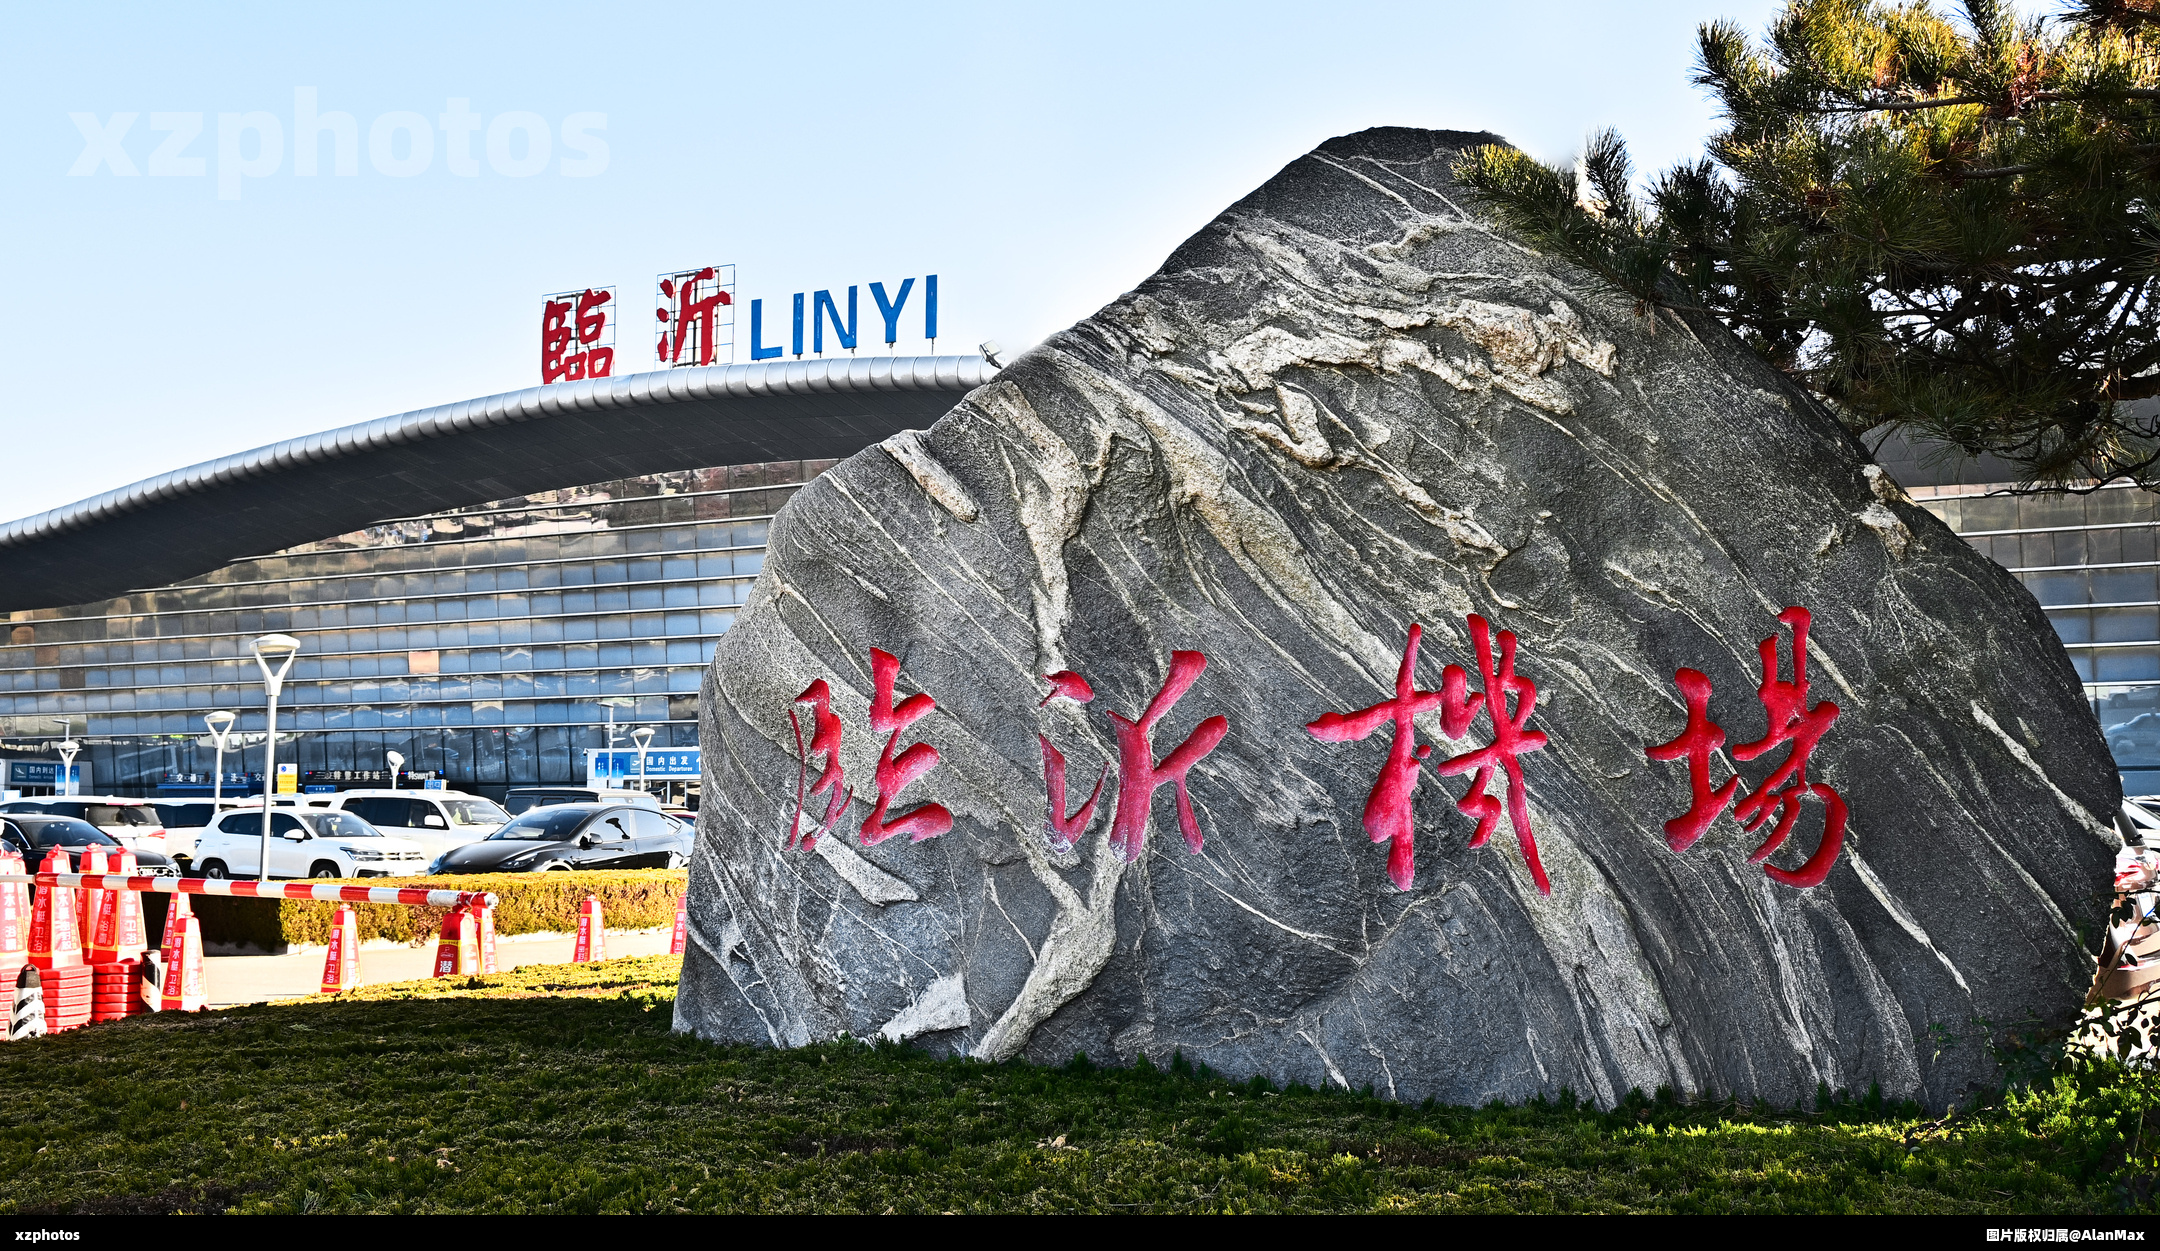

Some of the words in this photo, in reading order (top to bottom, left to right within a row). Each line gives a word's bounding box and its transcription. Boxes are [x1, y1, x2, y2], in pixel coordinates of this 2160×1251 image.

[751, 274, 938, 361] LINYI
[646, 756, 689, 766] 国内出发
[29, 766, 54, 775] 国内到达
